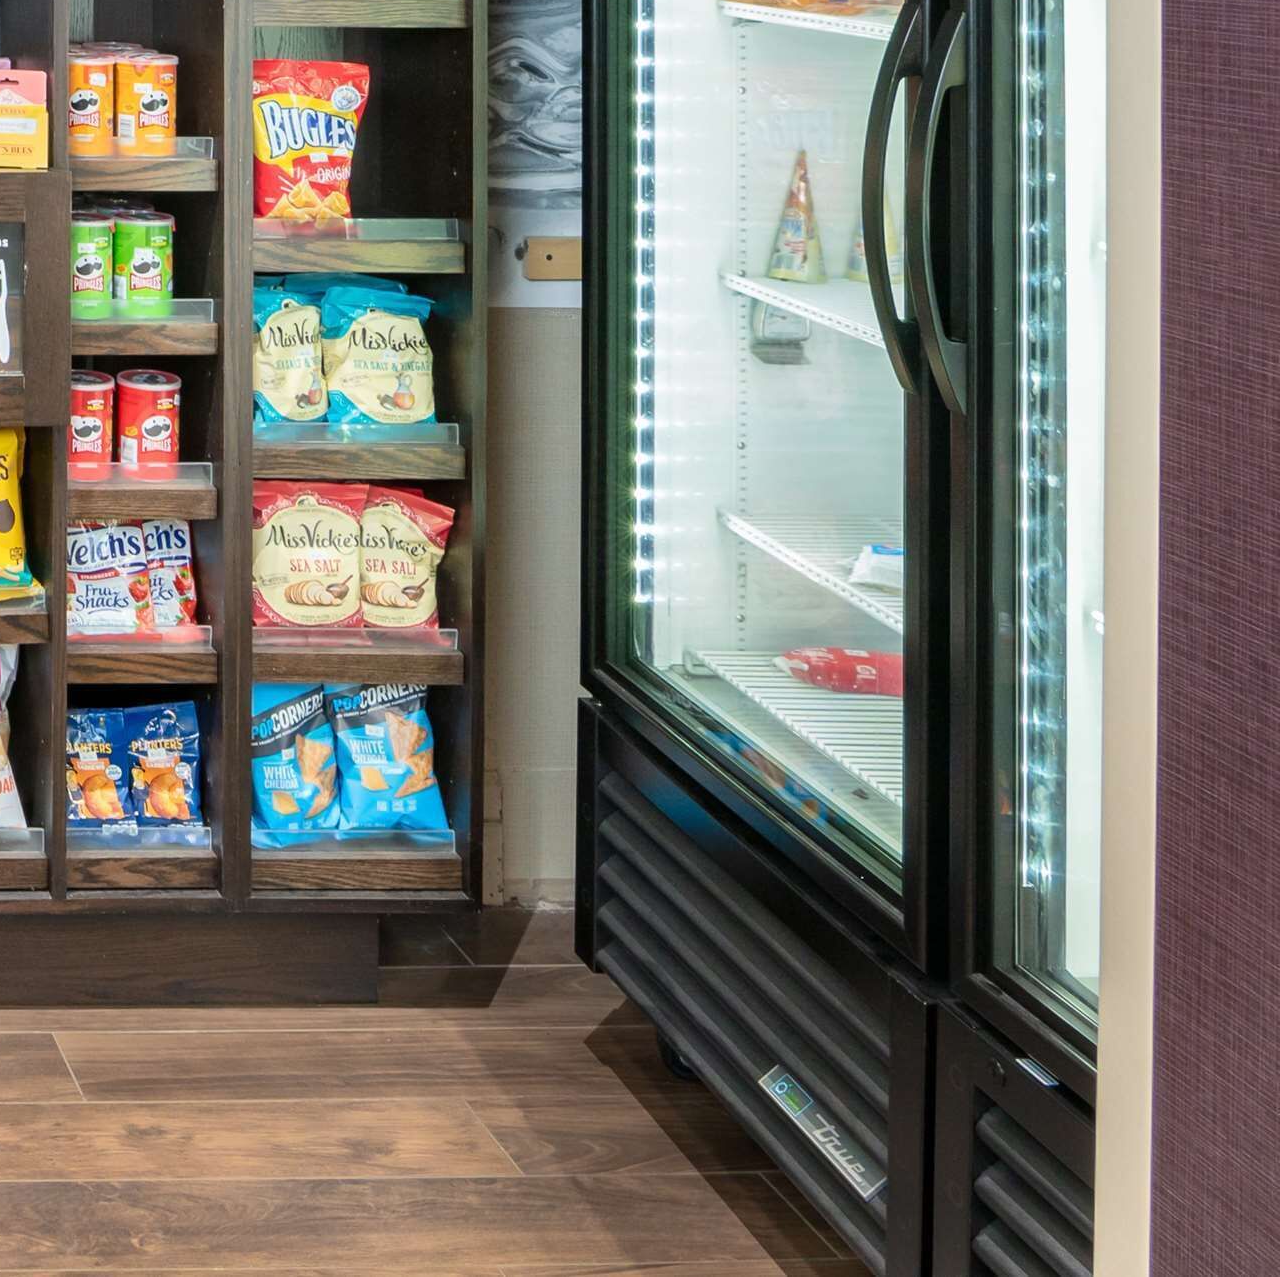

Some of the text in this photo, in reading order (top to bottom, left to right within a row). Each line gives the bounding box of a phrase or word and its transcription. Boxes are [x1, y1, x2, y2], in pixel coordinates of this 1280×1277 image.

[259, 100, 356, 159] BUGLES
[11, 146, 33, 154] BEES
[266, 520, 361, 555] Miss Vickie's
[291, 559, 341, 573] SEA SALT
[365, 559, 417, 575] SEA SALT
[79, 572, 116, 581] STRAWBERRY
[76, 596, 129, 611] Snacks
[131, 738, 184, 752] PLANTERS
[349, 740, 385, 754] WHITE
[264, 765, 296, 780] WHITE
